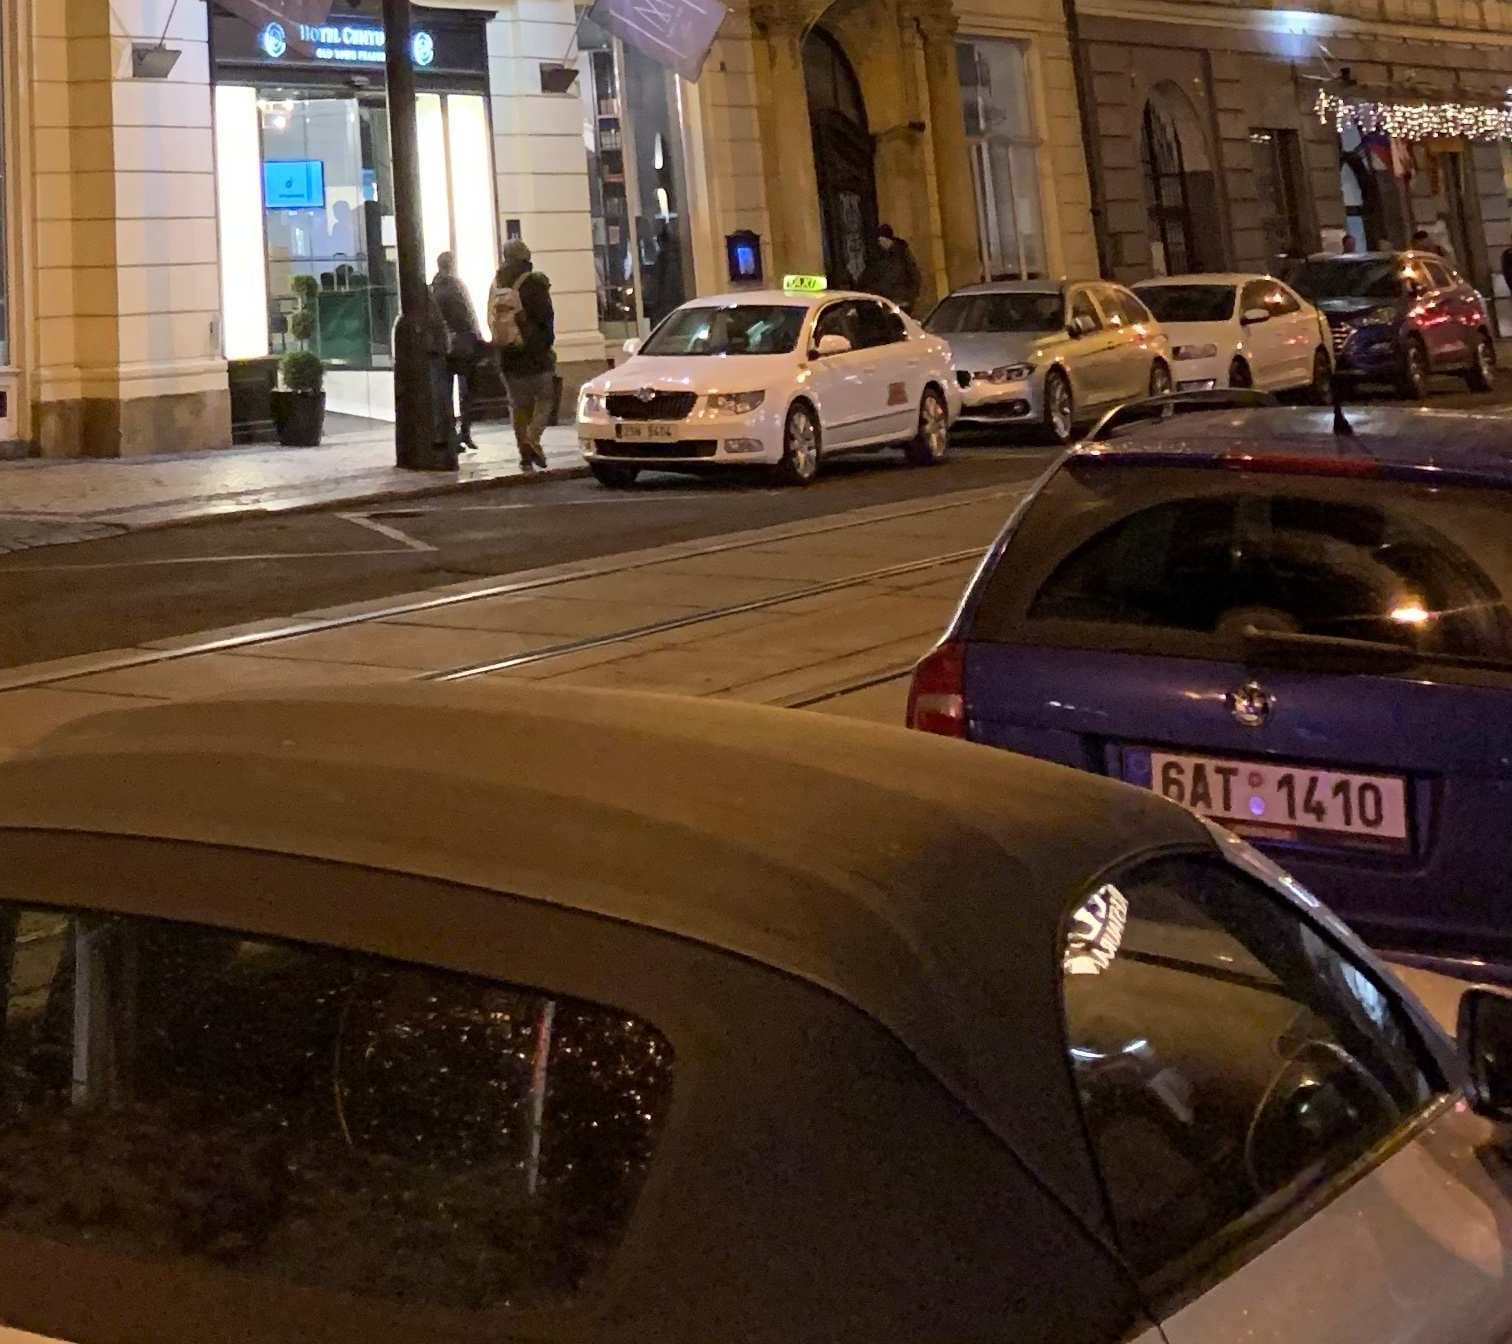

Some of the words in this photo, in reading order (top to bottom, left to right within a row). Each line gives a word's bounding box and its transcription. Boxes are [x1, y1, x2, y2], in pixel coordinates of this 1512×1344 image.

[342, 26, 386, 46] CENTU
[1161, 761, 1239, 812] 6AT
[1277, 772, 1384, 829] 1410
